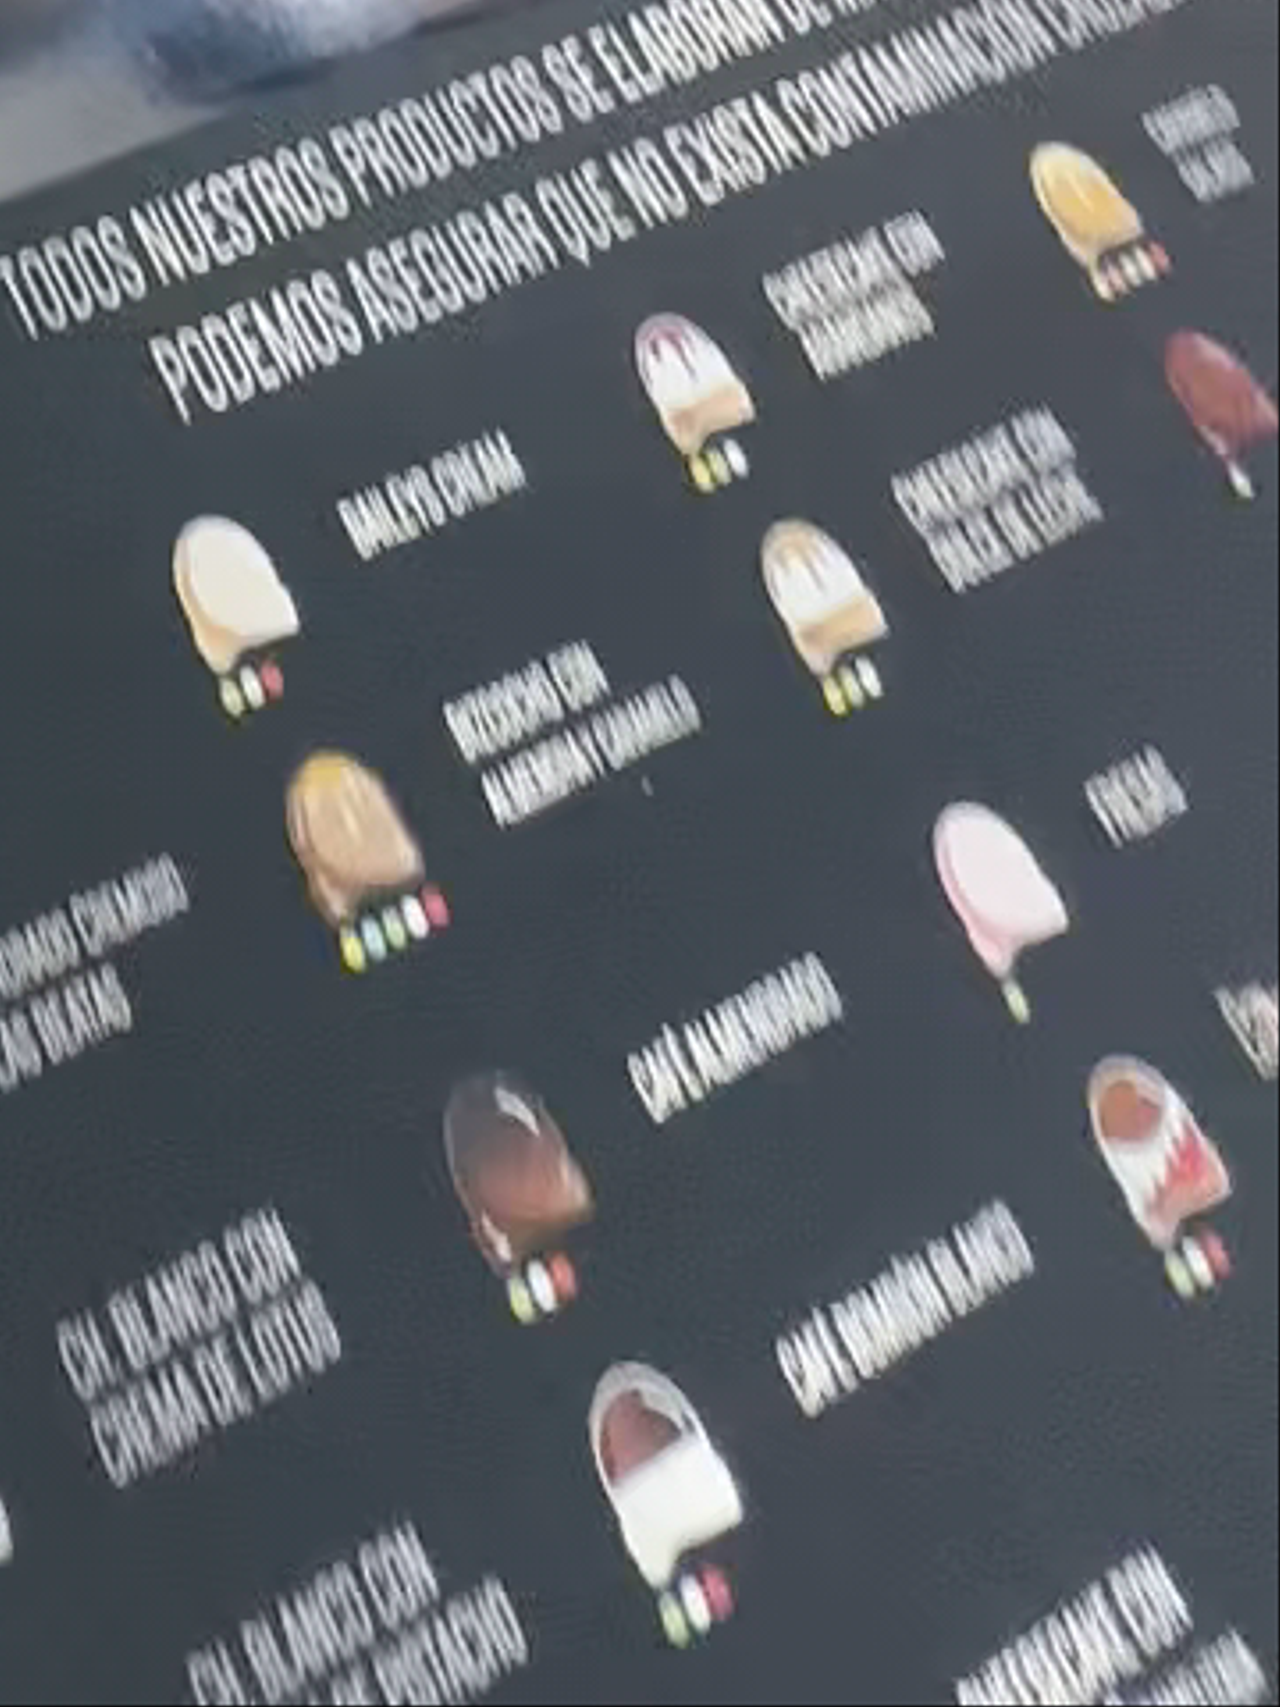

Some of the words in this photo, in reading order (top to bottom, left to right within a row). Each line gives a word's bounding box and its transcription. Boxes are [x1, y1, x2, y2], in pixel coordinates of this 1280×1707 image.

[129, 136, 350, 288] NUESTROS
[328, 54, 564, 208] PRODUCTOS
[540, 33, 614, 125] SE
[146, 268, 364, 427] PODEMOS
[345, 192, 561, 344] ASEGURAR
[533, 157, 636, 269] QUE
[606, 136, 689, 230] NO
[662, 91, 808, 208] EXISTA
[337, 463, 448, 561] BAILEYS
[429, 426, 527, 518] CREAM
[90, 1360, 213, 1490] CREMA
[193, 1332, 254, 1427] DE
[233, 1279, 342, 1404] LOTUS
[108, 1239, 239, 1373] BLANCO
[222, 1205, 303, 1307] CON
[238, 1560, 375, 1707] BLANCO
[357, 1518, 440, 1631] CON
